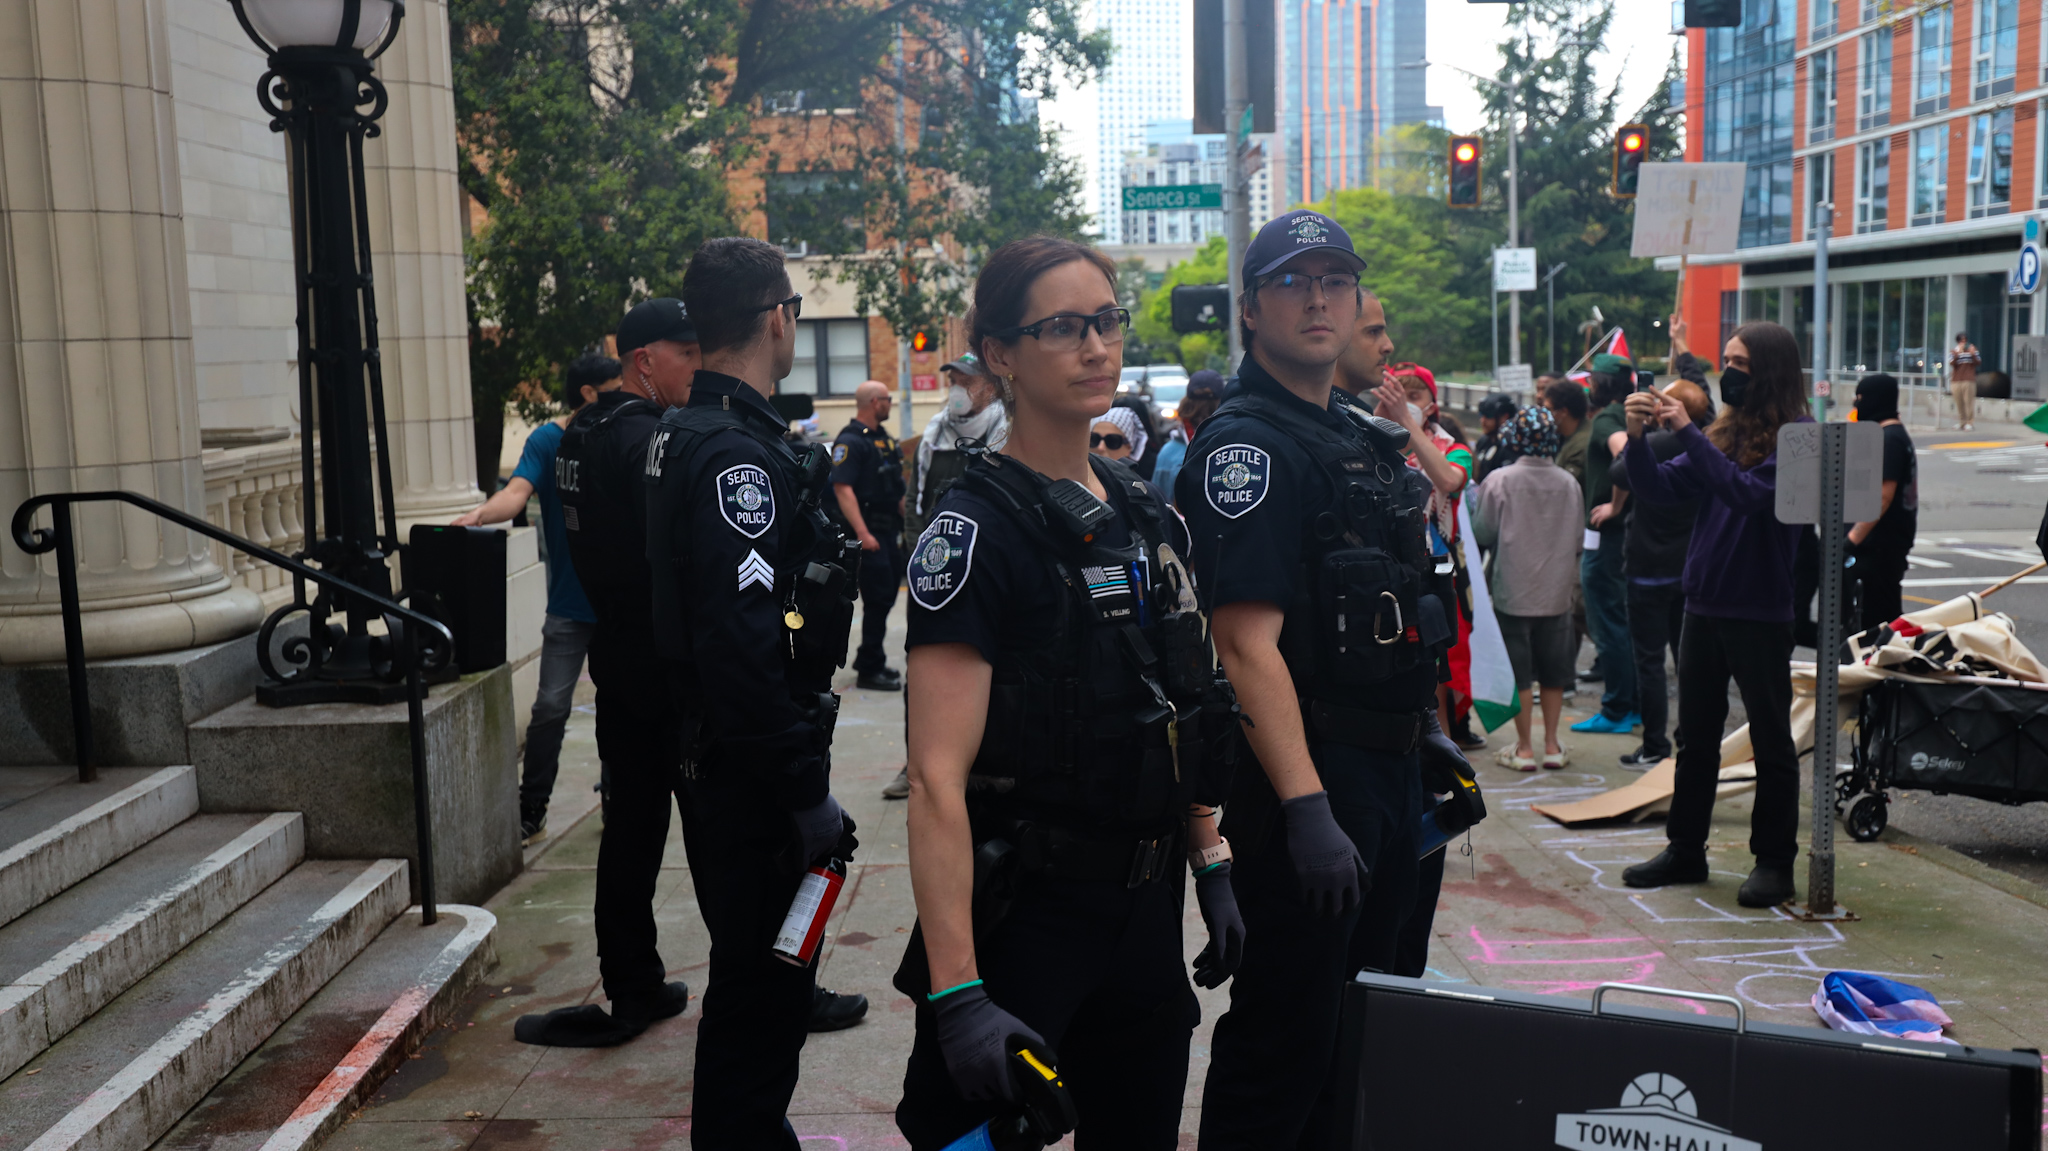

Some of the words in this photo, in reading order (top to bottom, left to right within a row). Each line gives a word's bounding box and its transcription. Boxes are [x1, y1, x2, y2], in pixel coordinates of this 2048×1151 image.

[1125, 188, 1185, 208] Seneca
[1187, 191, 1201, 206] St
[1291, 215, 1324, 225] SEATTLE
[1296, 236, 1327, 244] POLICE
[2023, 251, 2037, 286] P
[1215, 449, 1261, 466] SEATTLE
[727, 470, 766, 486] SEATTLE
[1217, 490, 1253, 504] POLICE
[736, 512, 767, 524] POLICE
[916, 572, 952, 593] POLICE
[1576, 1121, 1651, 1151] TOWN
